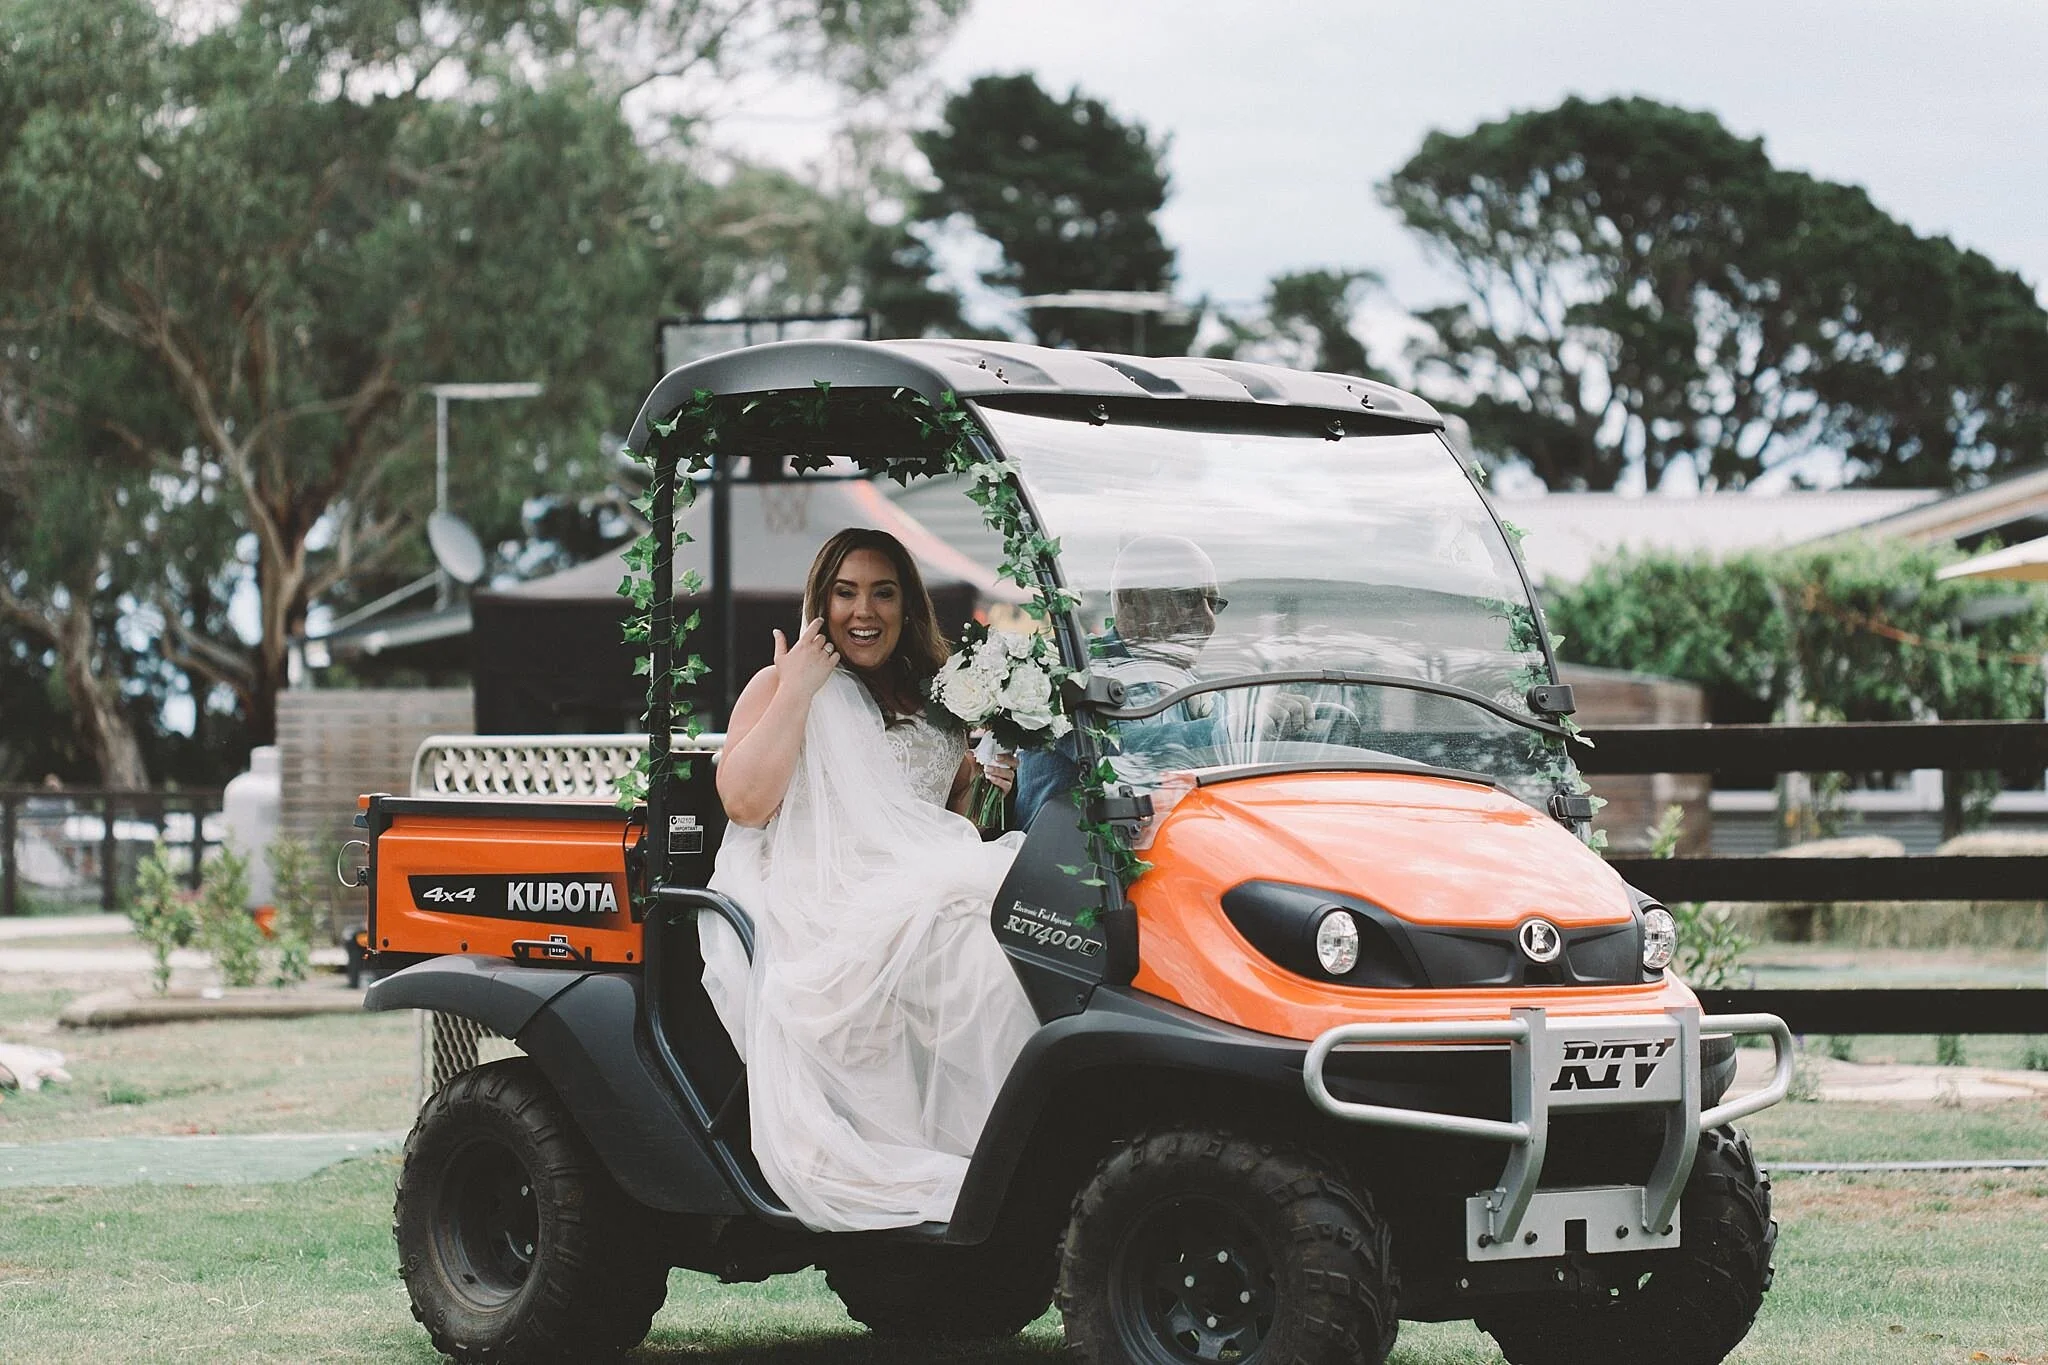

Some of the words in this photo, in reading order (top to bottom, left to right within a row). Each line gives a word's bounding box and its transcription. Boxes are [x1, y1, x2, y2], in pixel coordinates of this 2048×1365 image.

[423, 887, 476, 903] 4x4
[507, 881, 619, 913] KUBOTA
[1550, 1038, 1676, 1091] RTV
